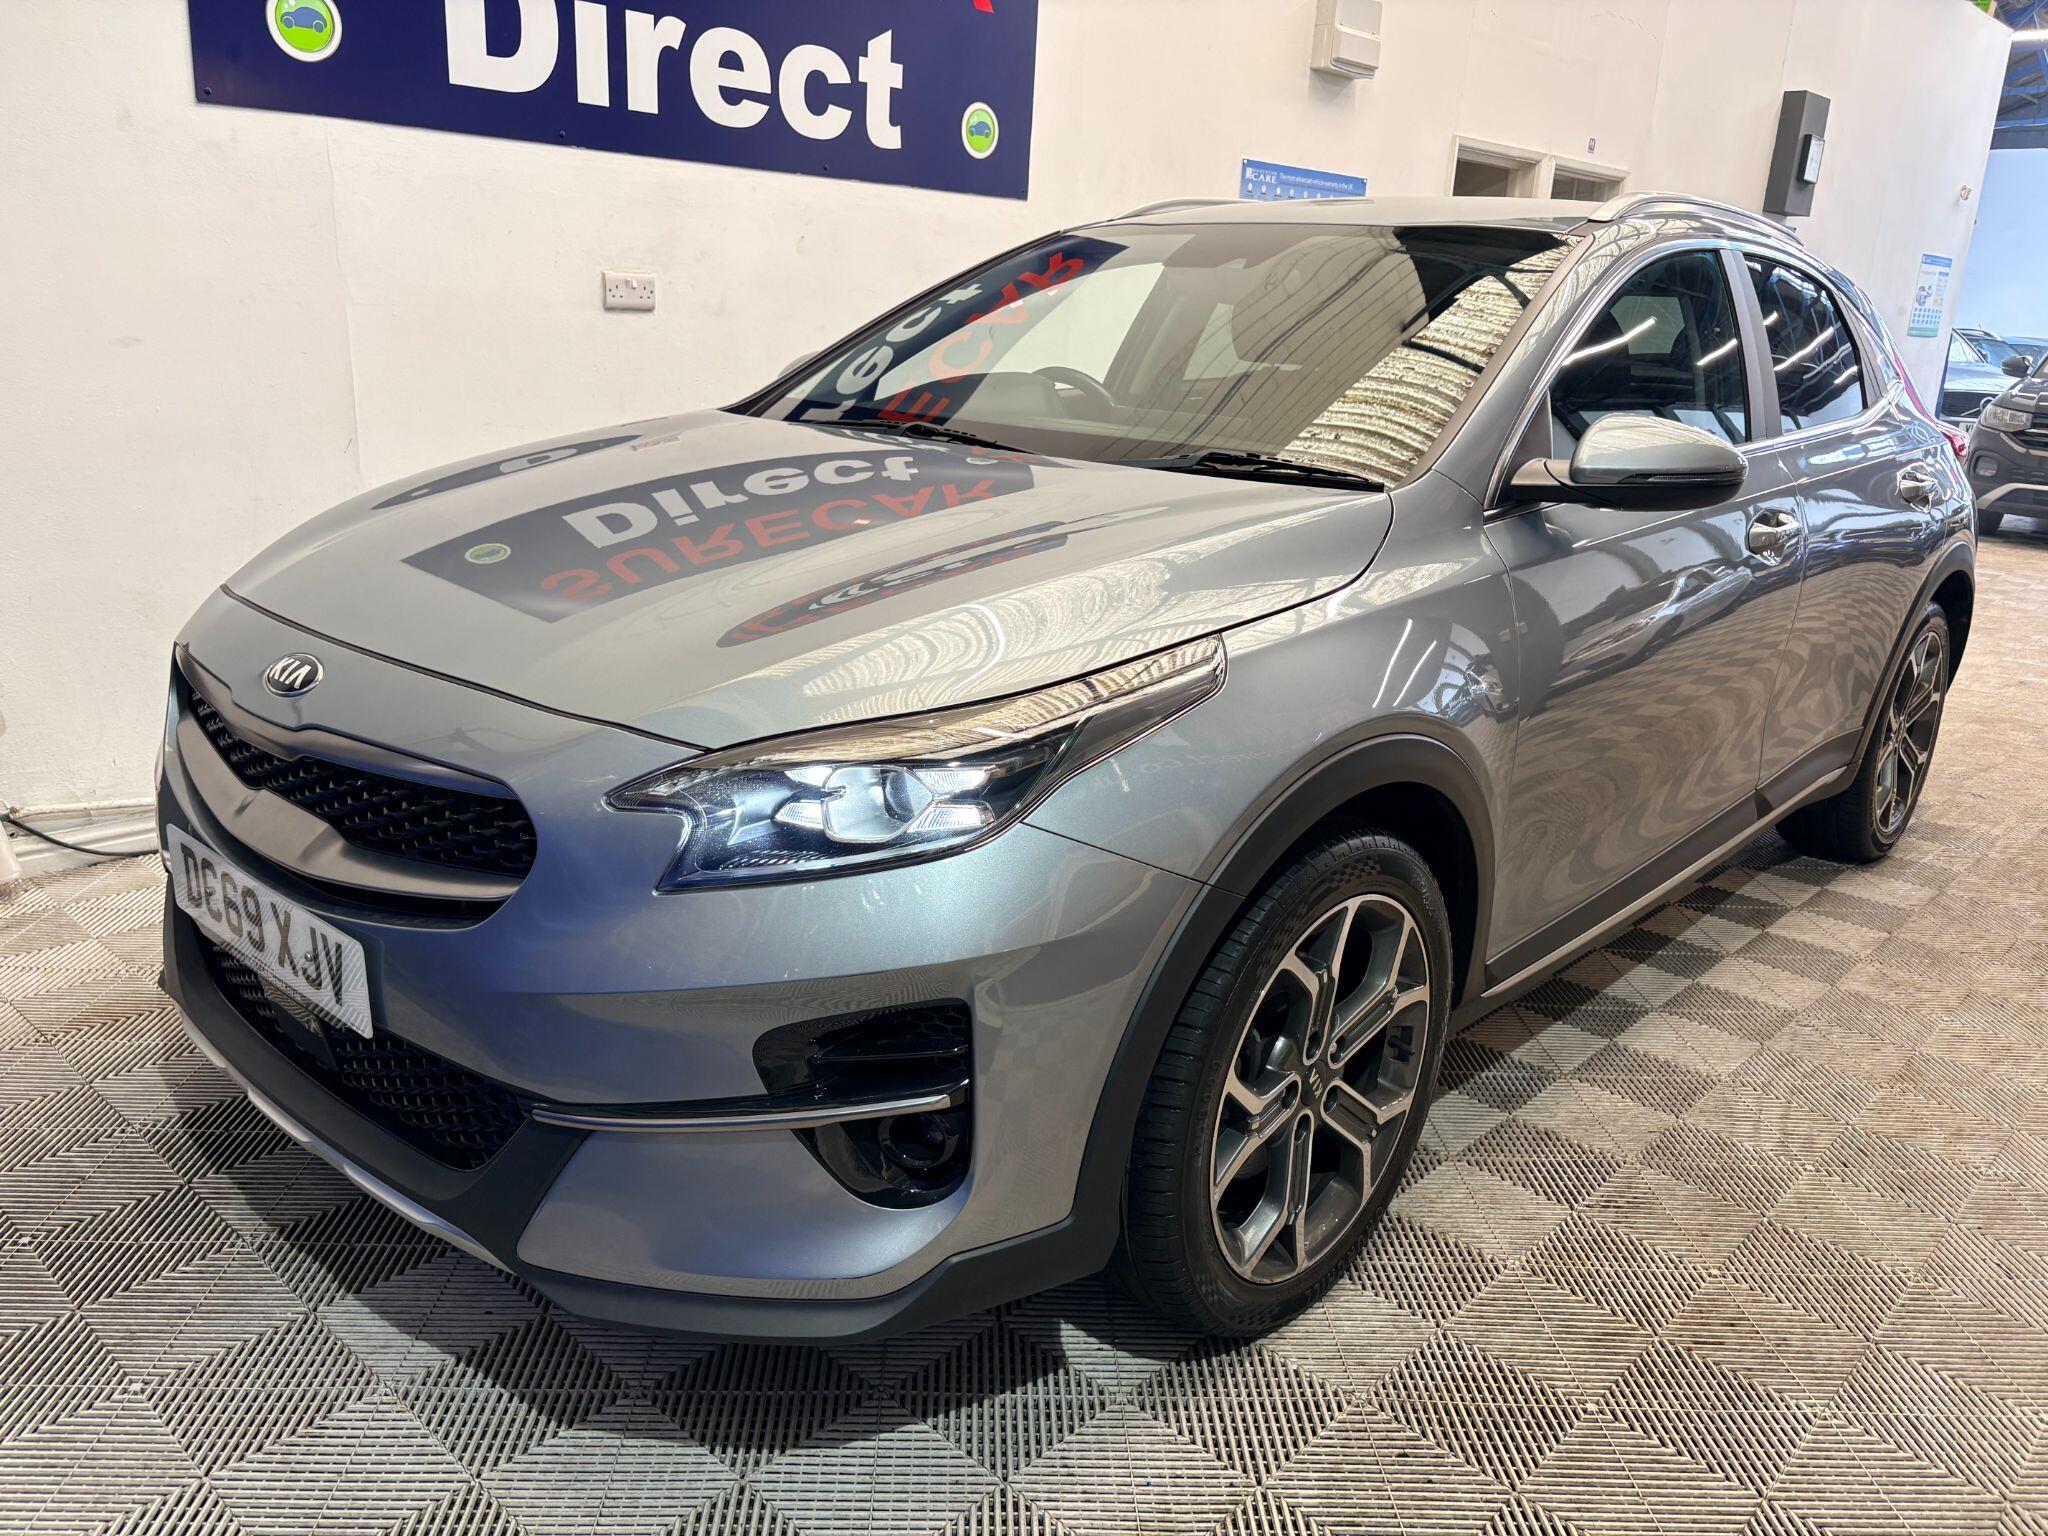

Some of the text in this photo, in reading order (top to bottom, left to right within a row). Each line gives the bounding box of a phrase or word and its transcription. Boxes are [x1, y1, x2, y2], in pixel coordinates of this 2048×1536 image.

[444, 0, 903, 150] Direct
[1252, 173, 1277, 184] CARE
[269, 657, 311, 689] KIA
[181, 843, 342, 1007] DE69 XJV
